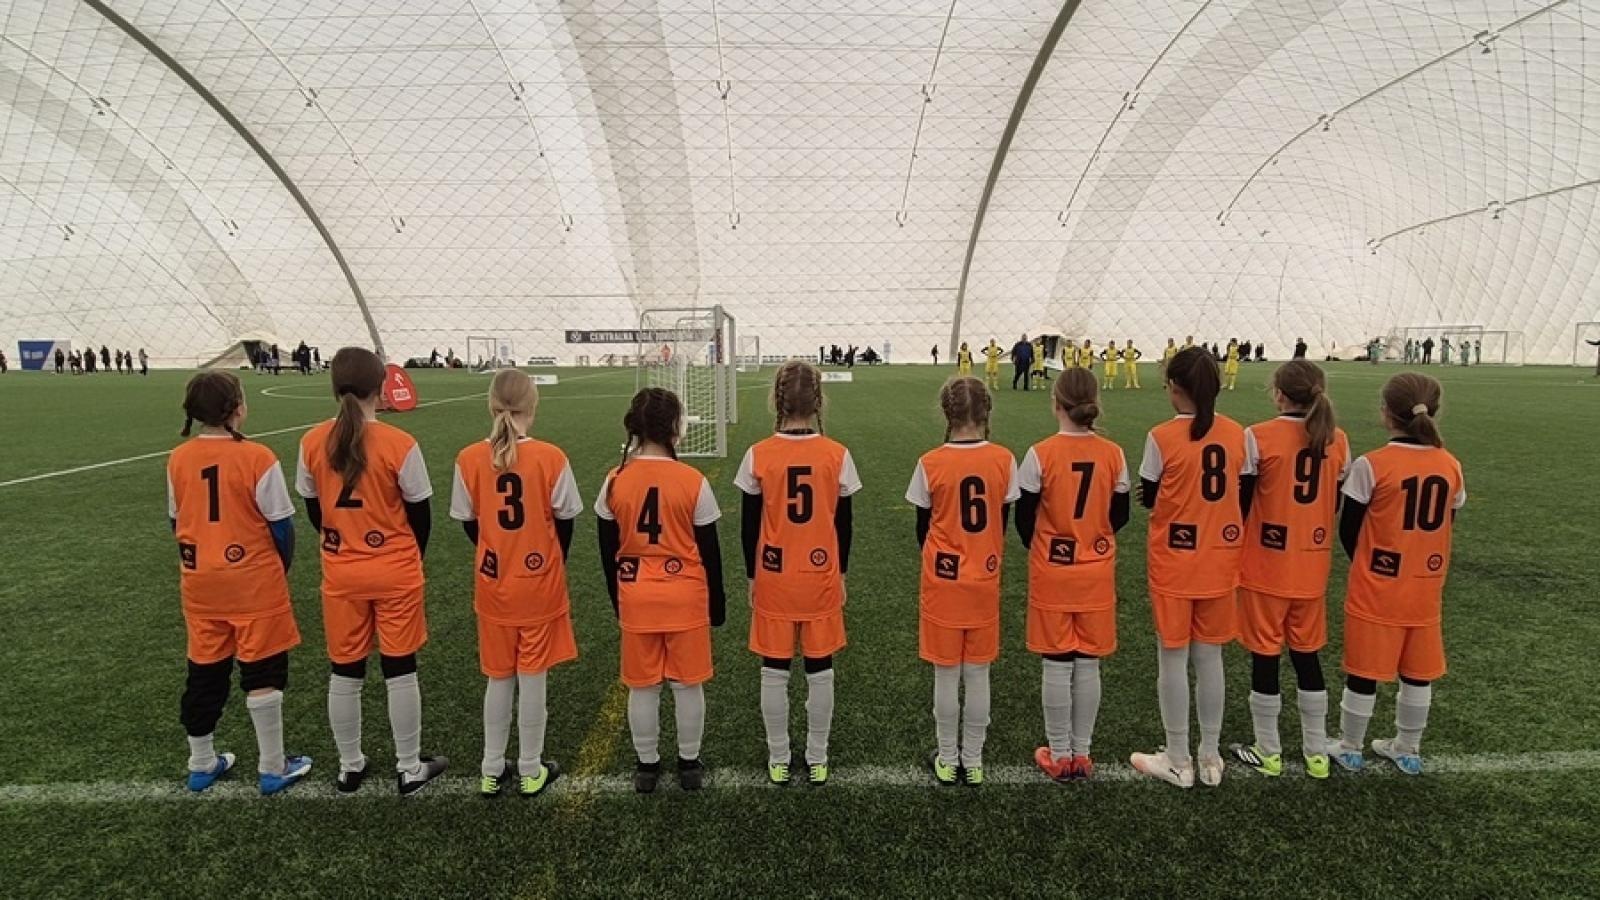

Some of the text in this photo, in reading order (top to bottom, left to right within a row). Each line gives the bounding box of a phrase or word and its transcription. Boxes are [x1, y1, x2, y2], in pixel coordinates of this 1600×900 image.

[201, 464, 221, 522] 1
[496, 472, 525, 530] 3
[787, 466, 814, 524] 5
[1071, 462, 1095, 520] 7
[1201, 444, 1227, 502] 8
[1293, 447, 1322, 505] 9
[636, 486, 663, 545] 4
[959, 476, 988, 533] 6
[1401, 475, 1450, 532] 10
